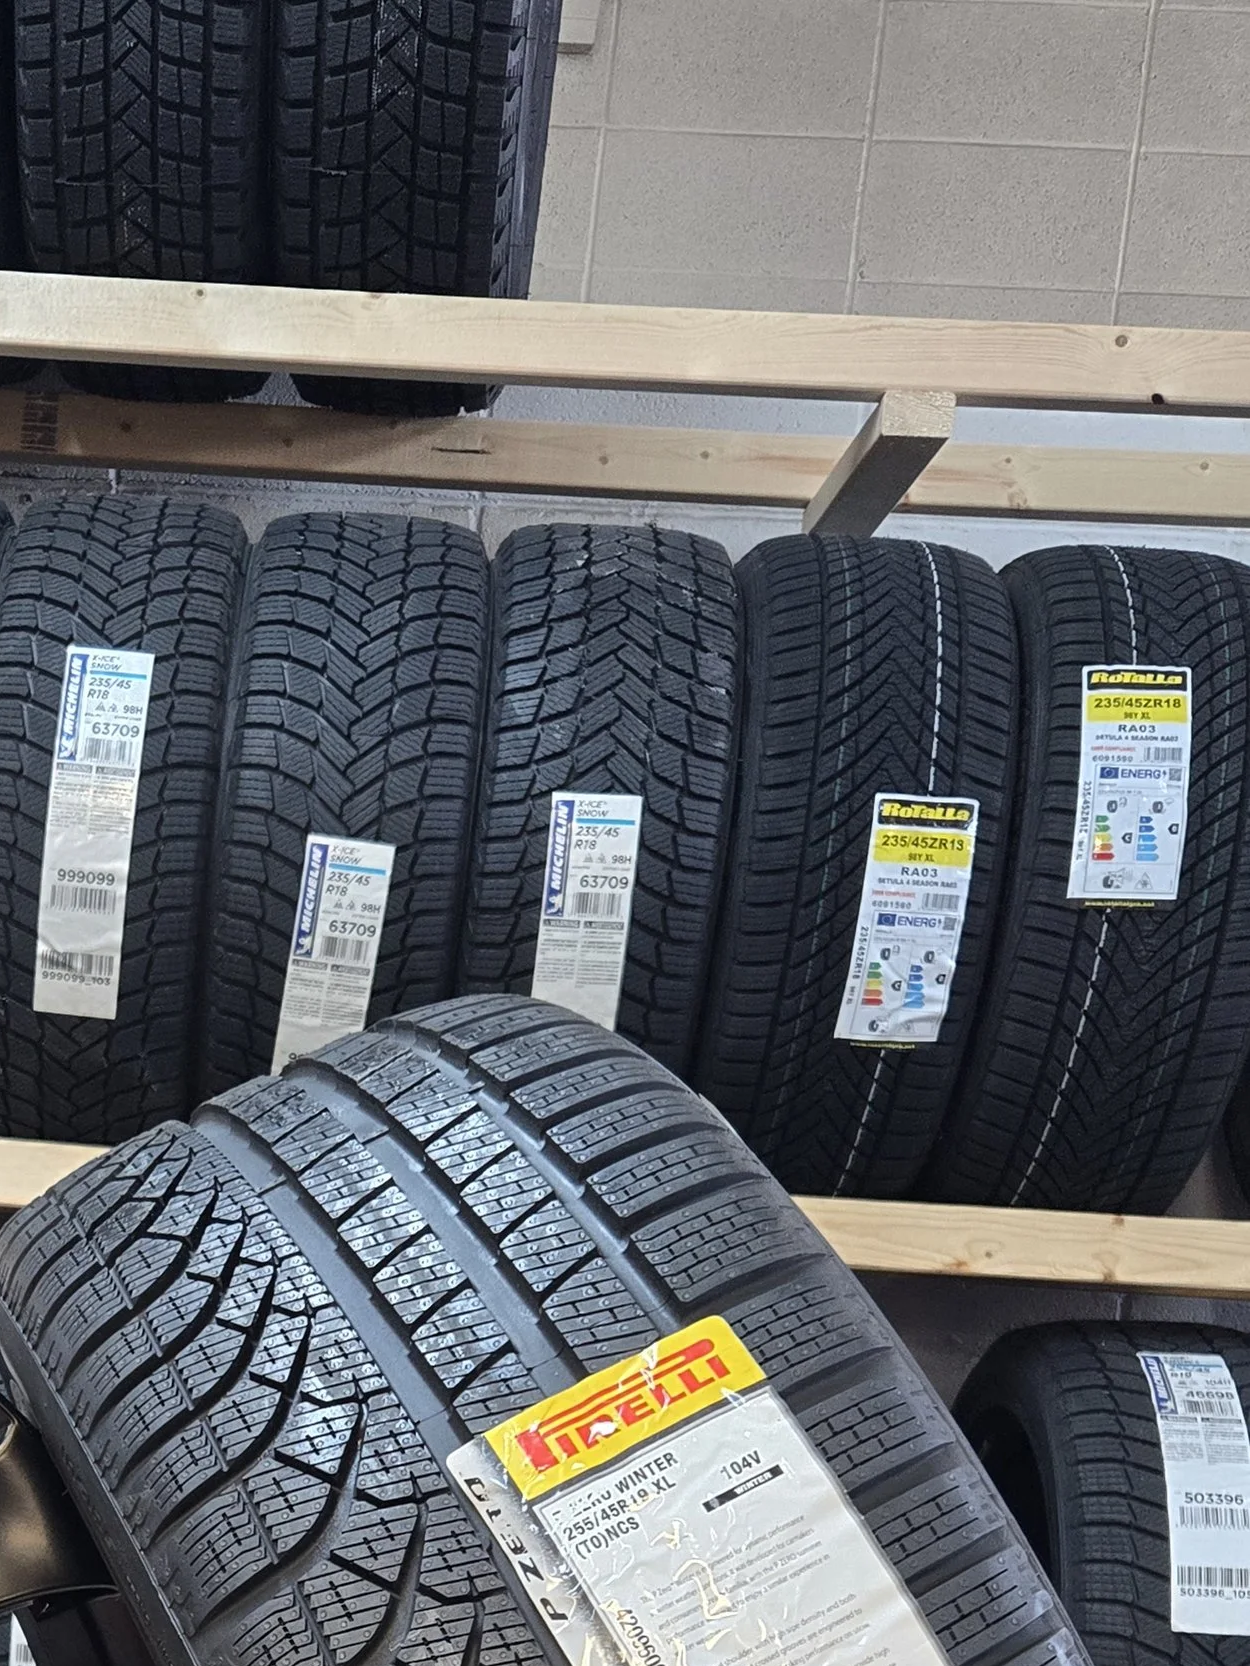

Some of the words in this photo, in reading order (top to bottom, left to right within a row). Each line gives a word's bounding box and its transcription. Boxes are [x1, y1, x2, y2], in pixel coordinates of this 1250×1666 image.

[89, 677, 132, 689] 235/45
[63, 657, 83, 732] MICHELIN
[87, 688, 109, 699] R18
[123, 705, 143, 714] 98H
[1093, 698, 1182, 709] 235/45ZR18
[1141, 711, 1152, 720] XL
[92, 722, 140, 738] 63709
[1118, 725, 1156, 733] RA03
[1121, 769, 1161, 779] ENERG
[576, 809, 609, 817] SNOW
[575, 826, 620, 838] 235/45
[551, 801, 569, 890] MICHELIN
[574, 840, 597, 850] R18
[329, 854, 362, 864] SNOW
[611, 855, 632, 864] 98H
[57, 868, 115, 885] 999099
[327, 871, 371, 886] 235/45
[901, 867, 938, 878] RA03
[580, 875, 628, 889] 63709
[300, 846, 324, 934] MICHELIN
[325, 884, 347, 897] R18
[360, 903, 381, 914] 98H
[329, 919, 376, 937] 63709
[897, 916, 937, 928] ENERG
[515, 1337, 730, 1473] PIRELLI
[717, 1447, 765, 1483] 104V
[611, 1448, 681, 1496] WINTER
[731, 1468, 774, 1497] WINTER
[1183, 1492, 1245, 1505] 503396
[560, 1485, 653, 1543] 255/45R19
[649, 1470, 678, 1496] XL
